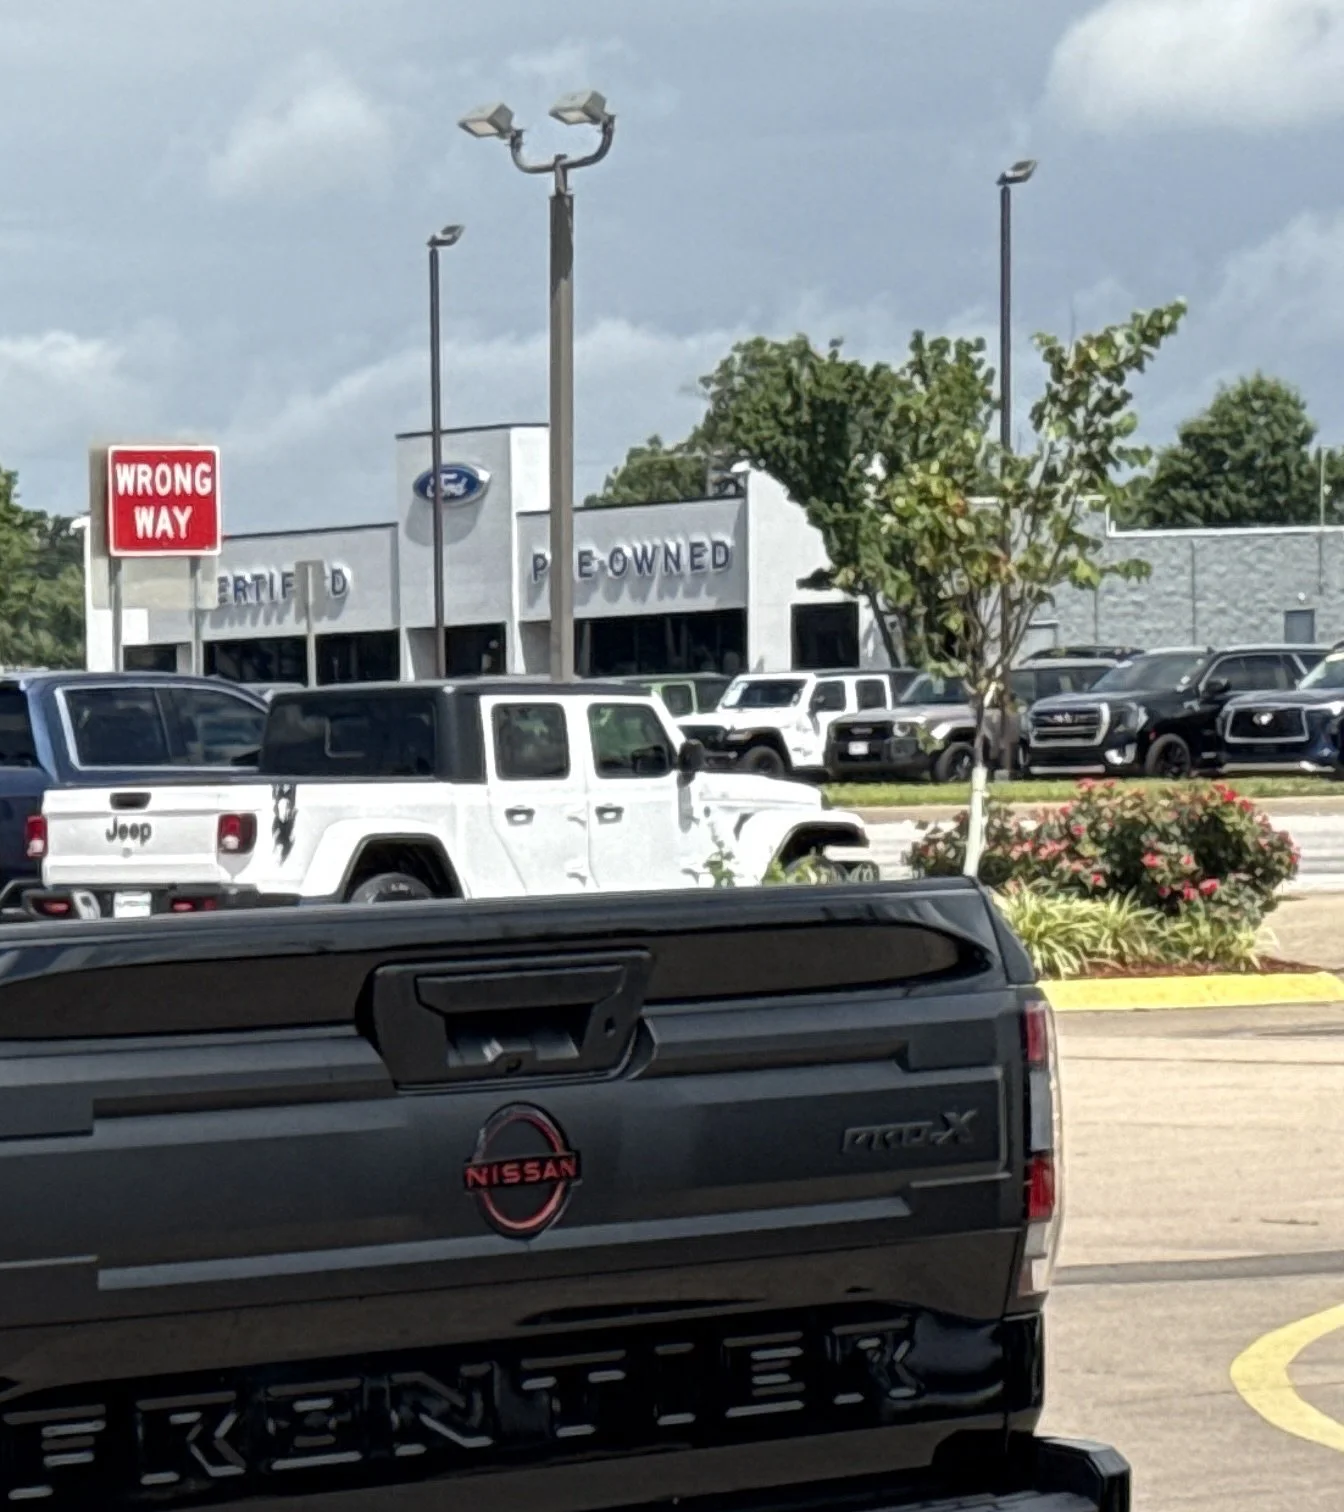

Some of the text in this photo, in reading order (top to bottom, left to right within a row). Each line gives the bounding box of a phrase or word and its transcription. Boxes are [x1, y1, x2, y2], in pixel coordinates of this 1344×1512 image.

[115, 461, 212, 497] WRONG
[134, 505, 193, 540] WAY
[217, 539, 731, 605] ERTIFD PE-OWNED
[105, 816, 153, 847] Jeep
[465, 1156, 578, 1189] NISSAN
[2, 1314, 928, 1502] FRONTIER
